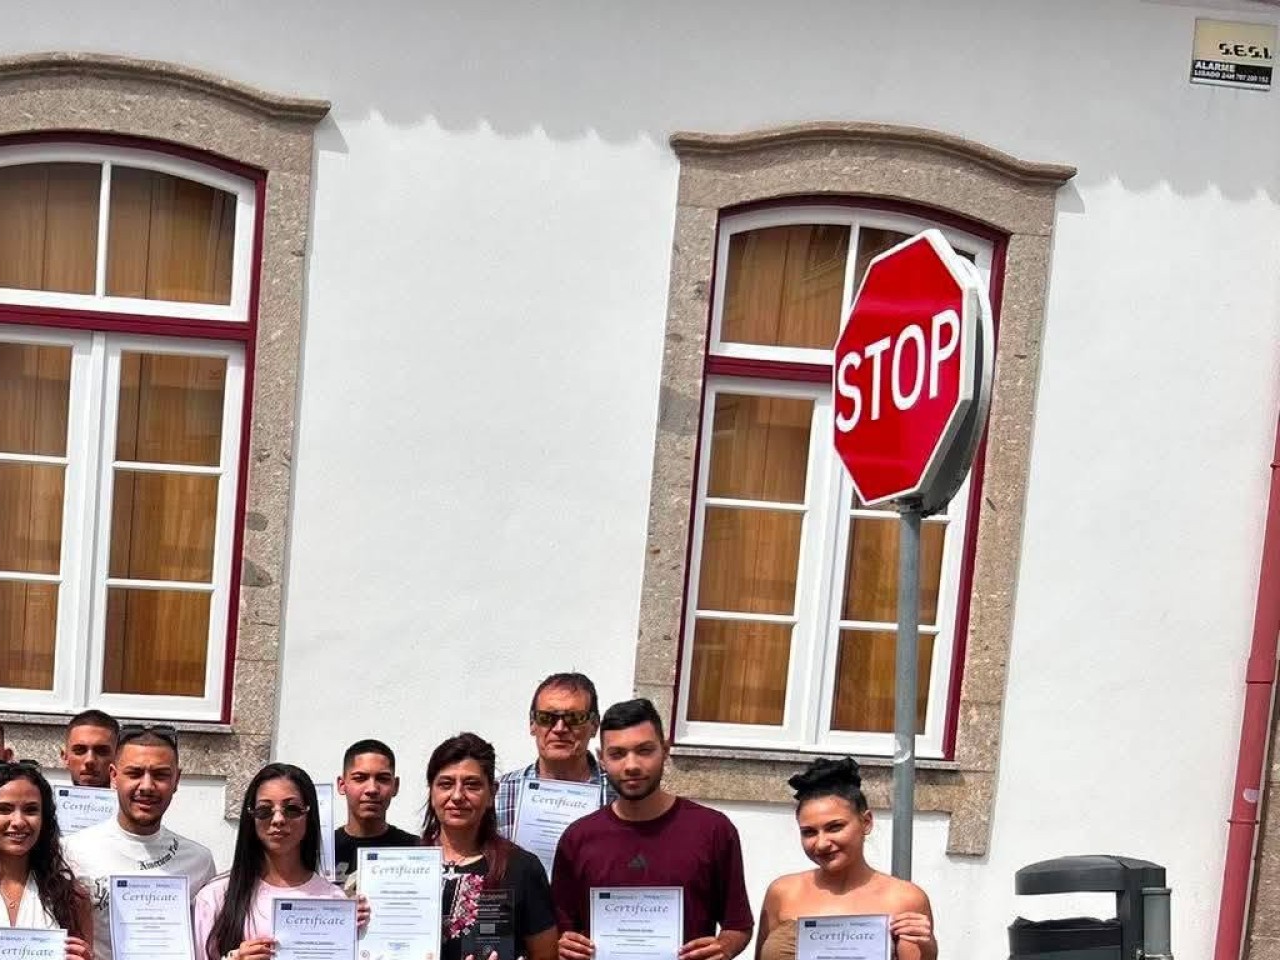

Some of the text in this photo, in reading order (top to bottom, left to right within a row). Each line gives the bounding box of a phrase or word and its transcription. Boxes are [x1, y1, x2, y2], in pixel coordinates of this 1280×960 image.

[1195, 61, 1236, 73] ALARME
[835, 309, 961, 432] STOP
[371, 865, 431, 877] Certificate
[122, 892, 178, 905] Certificate
[605, 903, 669, 914] Certificate
[285, 914, 345, 927] Certificate
[810, 931, 875, 943] Certificate
